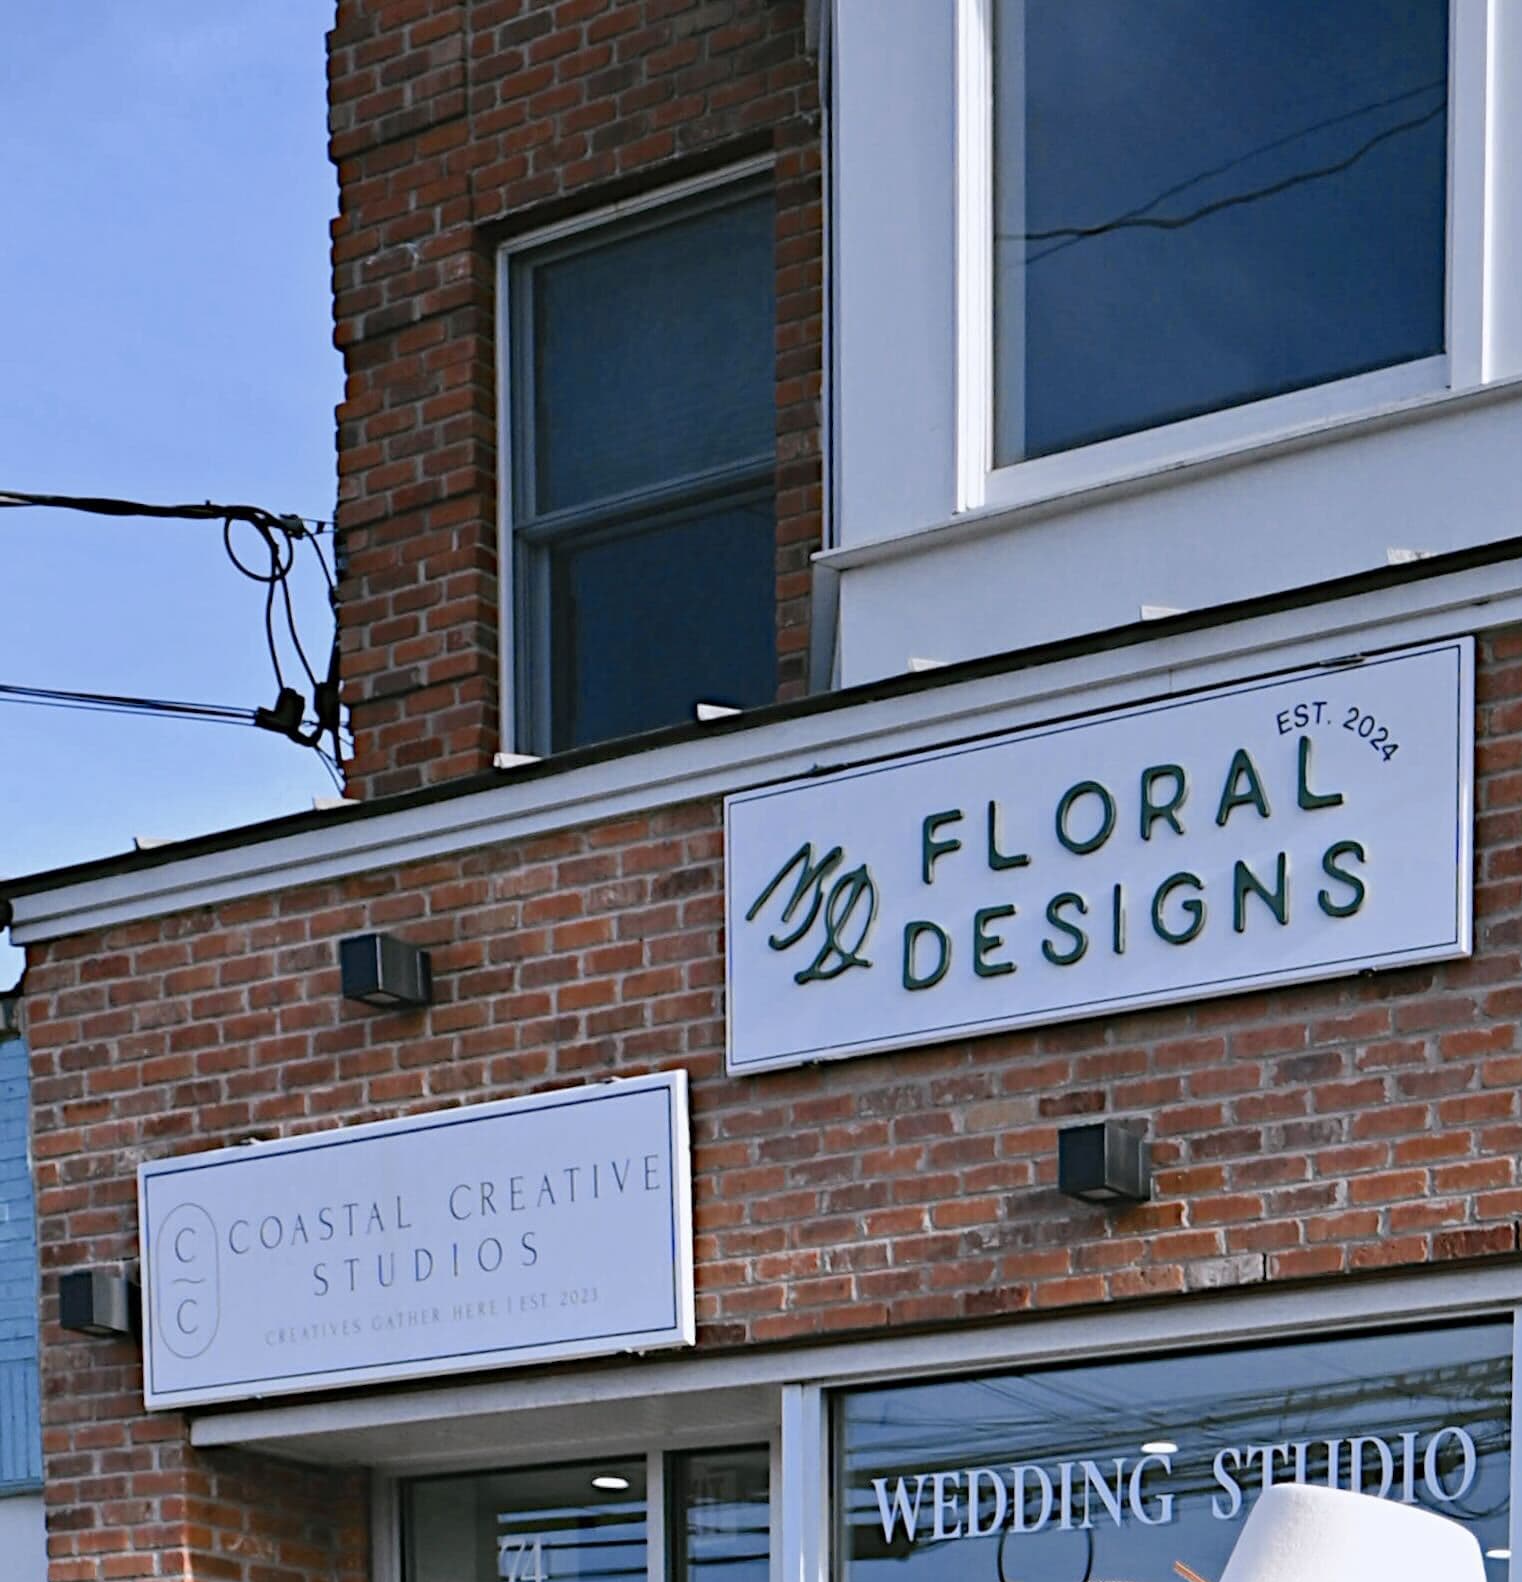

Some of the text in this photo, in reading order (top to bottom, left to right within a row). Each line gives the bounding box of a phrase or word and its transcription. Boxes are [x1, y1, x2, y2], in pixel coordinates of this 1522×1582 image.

[1276, 701, 1399, 762] EST. 2024
[922, 735, 1344, 884] FLORAL
[903, 840, 1367, 991] DESIGNS
[228, 1154, 662, 1255] COASTAL CREATIVE
[313, 1231, 540, 1297] STUDIOS
[264, 1319, 361, 1347] CREATIVES
[371, 1308, 440, 1332] GATHER
[452, 1299, 498, 1321] HERE
[872, 1426, 1476, 1545] WEDDING STUDIO
